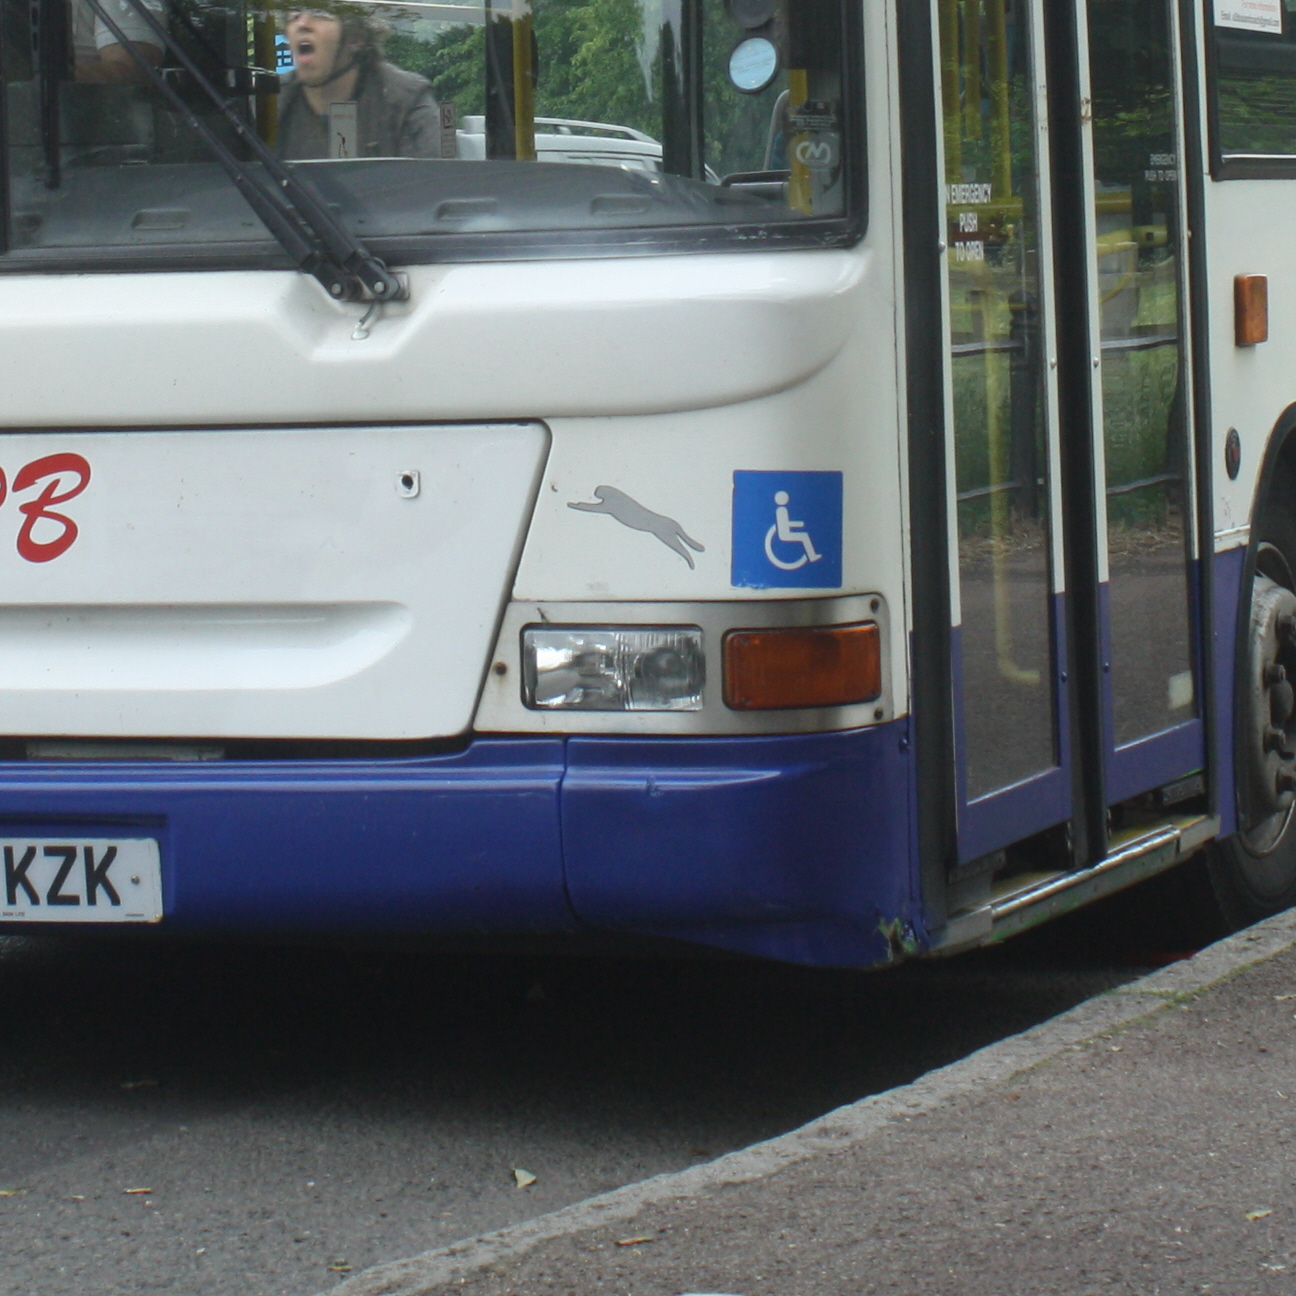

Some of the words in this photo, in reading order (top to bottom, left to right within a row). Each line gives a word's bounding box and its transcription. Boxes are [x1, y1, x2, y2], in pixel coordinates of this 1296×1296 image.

[951, 183, 992, 204] EMERGENCY
[959, 212, 978, 233] PUSH
[955, 241, 965, 262] TO
[965, 240, 984, 262] OPEN
[3, 845, 121, 906] KZK
